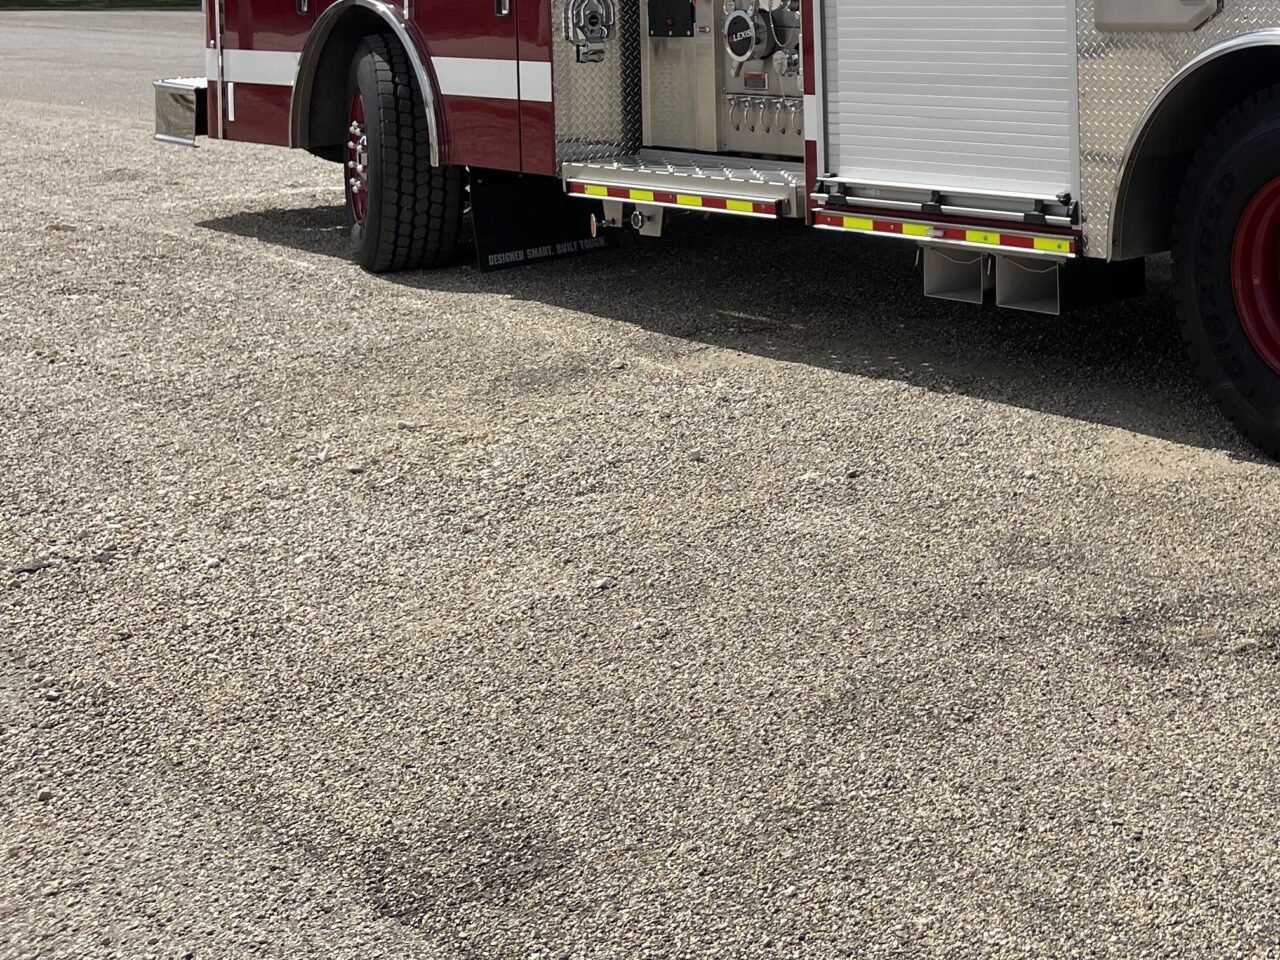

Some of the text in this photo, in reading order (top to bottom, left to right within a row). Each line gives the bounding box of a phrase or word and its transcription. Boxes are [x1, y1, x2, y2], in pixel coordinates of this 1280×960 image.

[488, 250, 525, 266] DESIGNED
[526, 245, 555, 260] SMART.
[556, 241, 578, 254] BUILT
